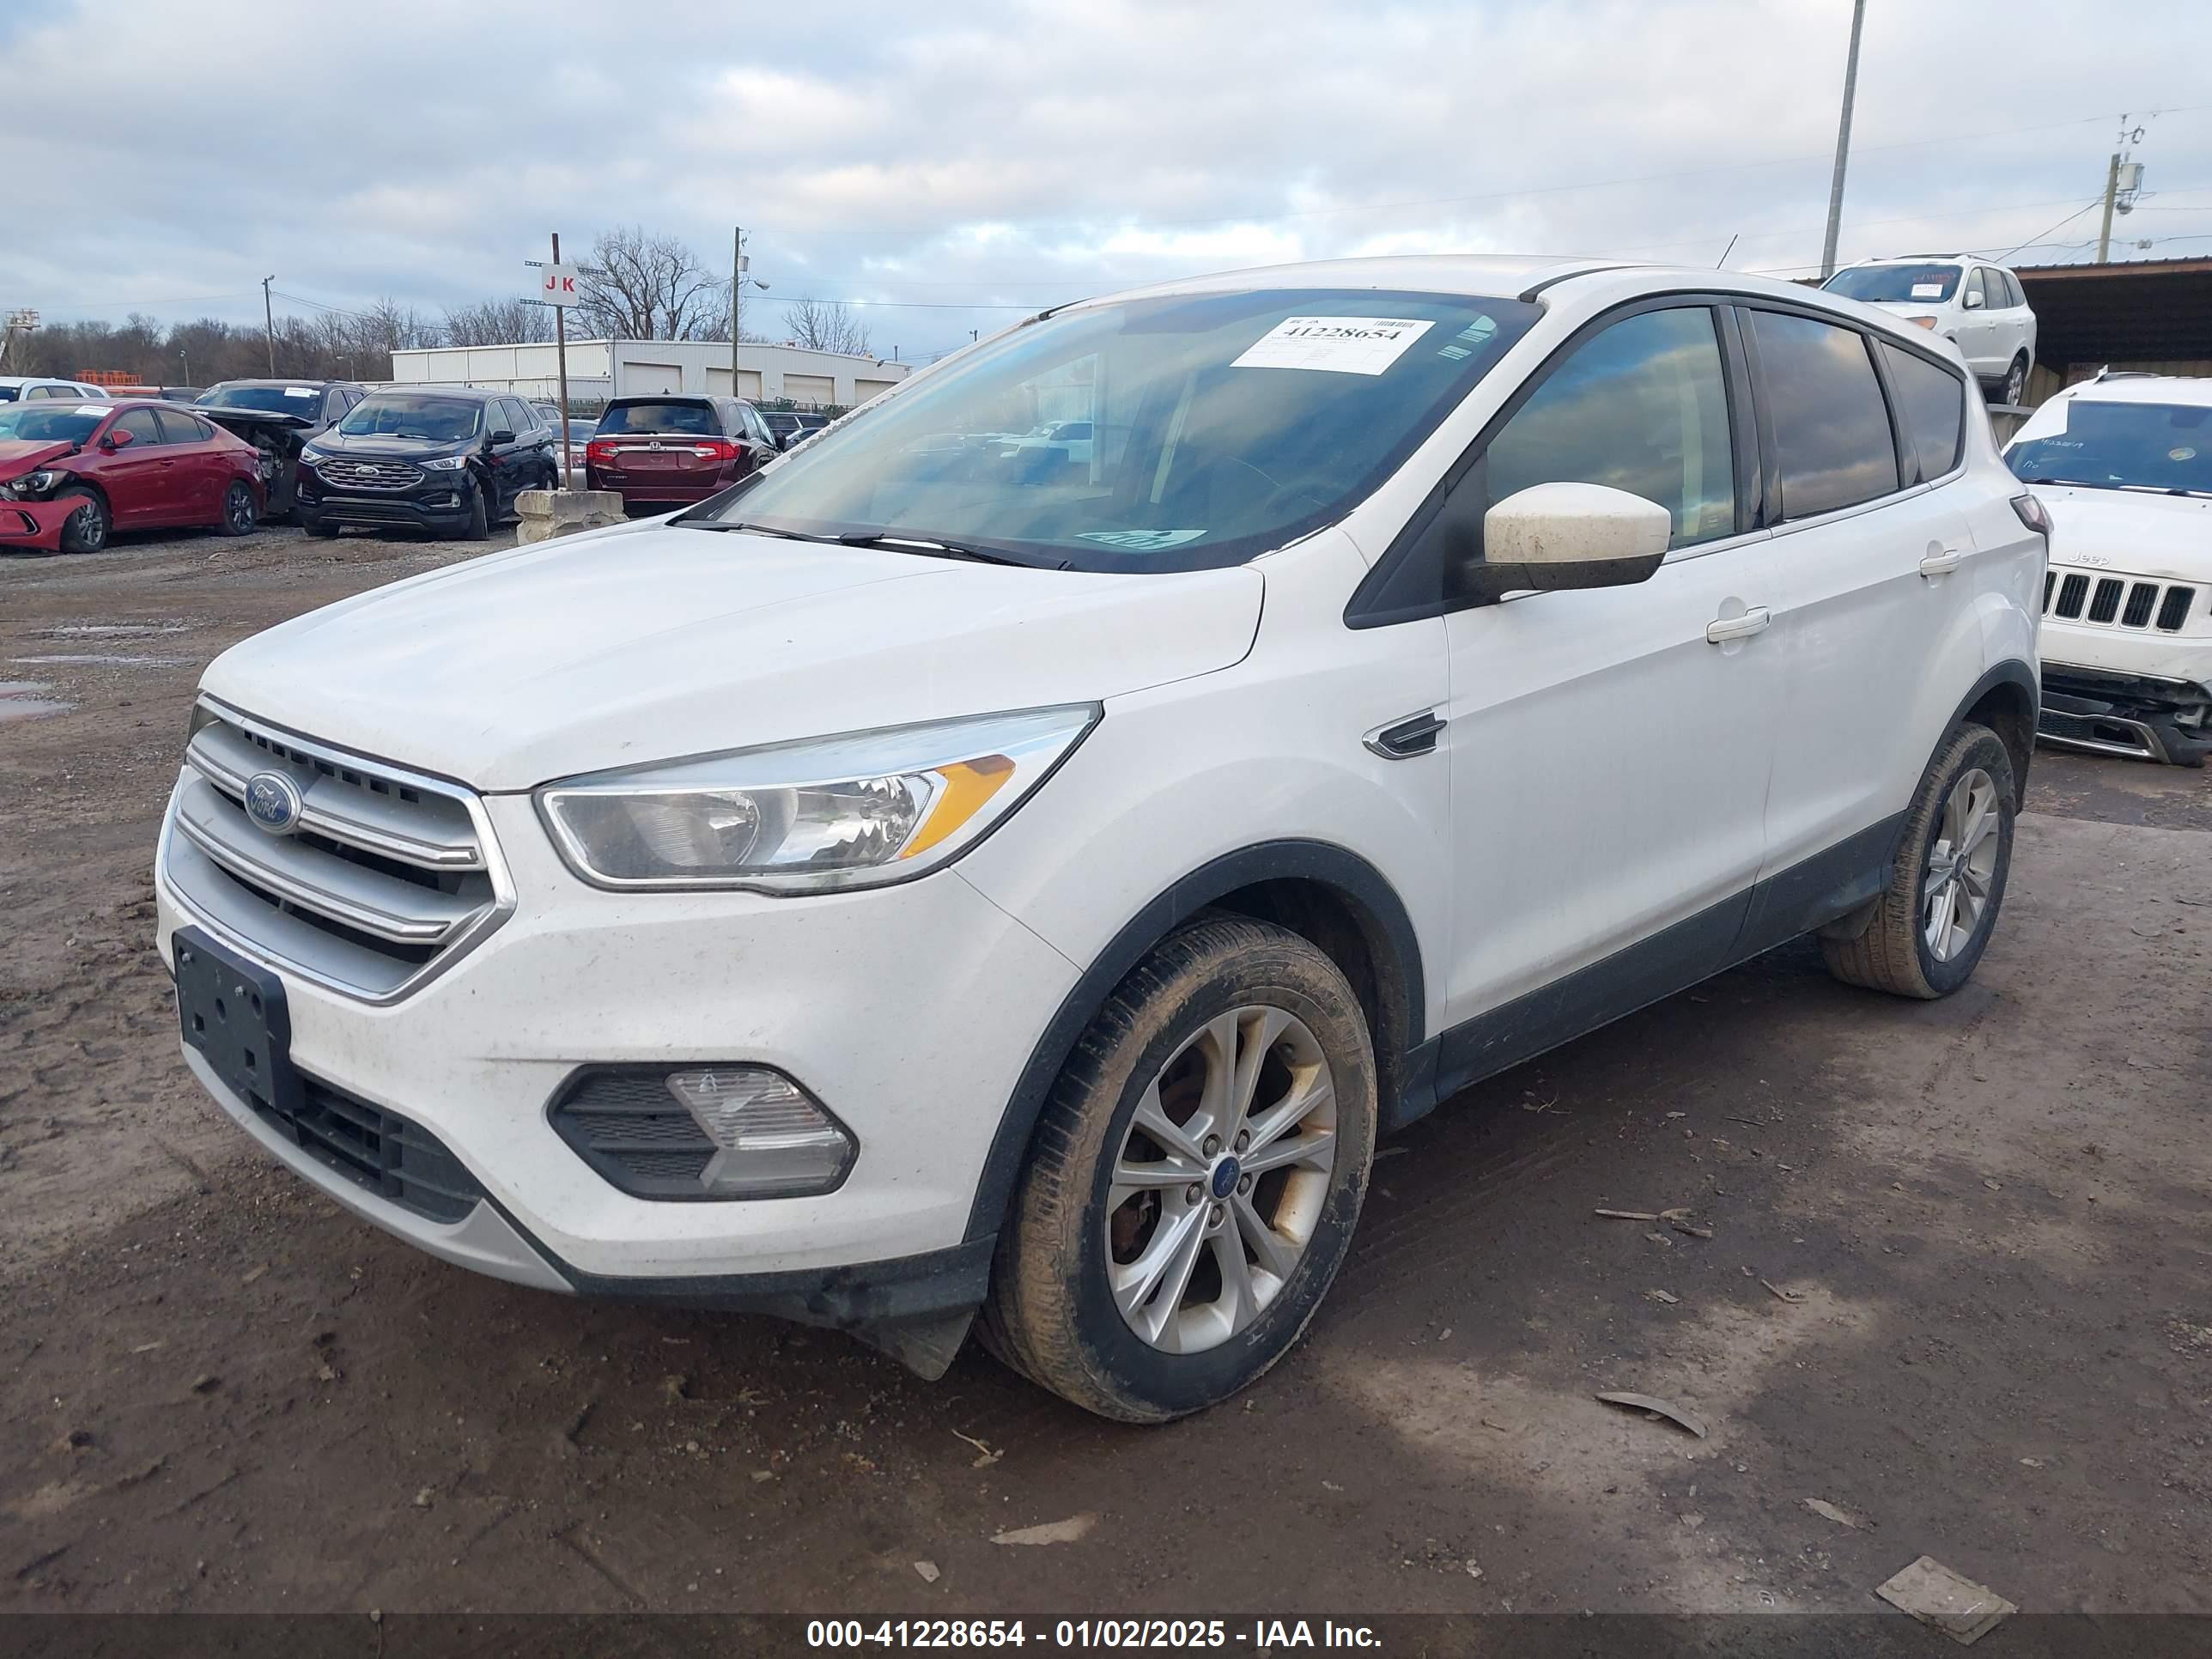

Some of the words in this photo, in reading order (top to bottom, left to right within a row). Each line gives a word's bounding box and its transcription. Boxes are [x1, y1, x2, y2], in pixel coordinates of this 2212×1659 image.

[1284, 327, 1402, 340] 41228654
[2069, 550, 2110, 566] Jeep
[250, 784, 280, 818] Ford
